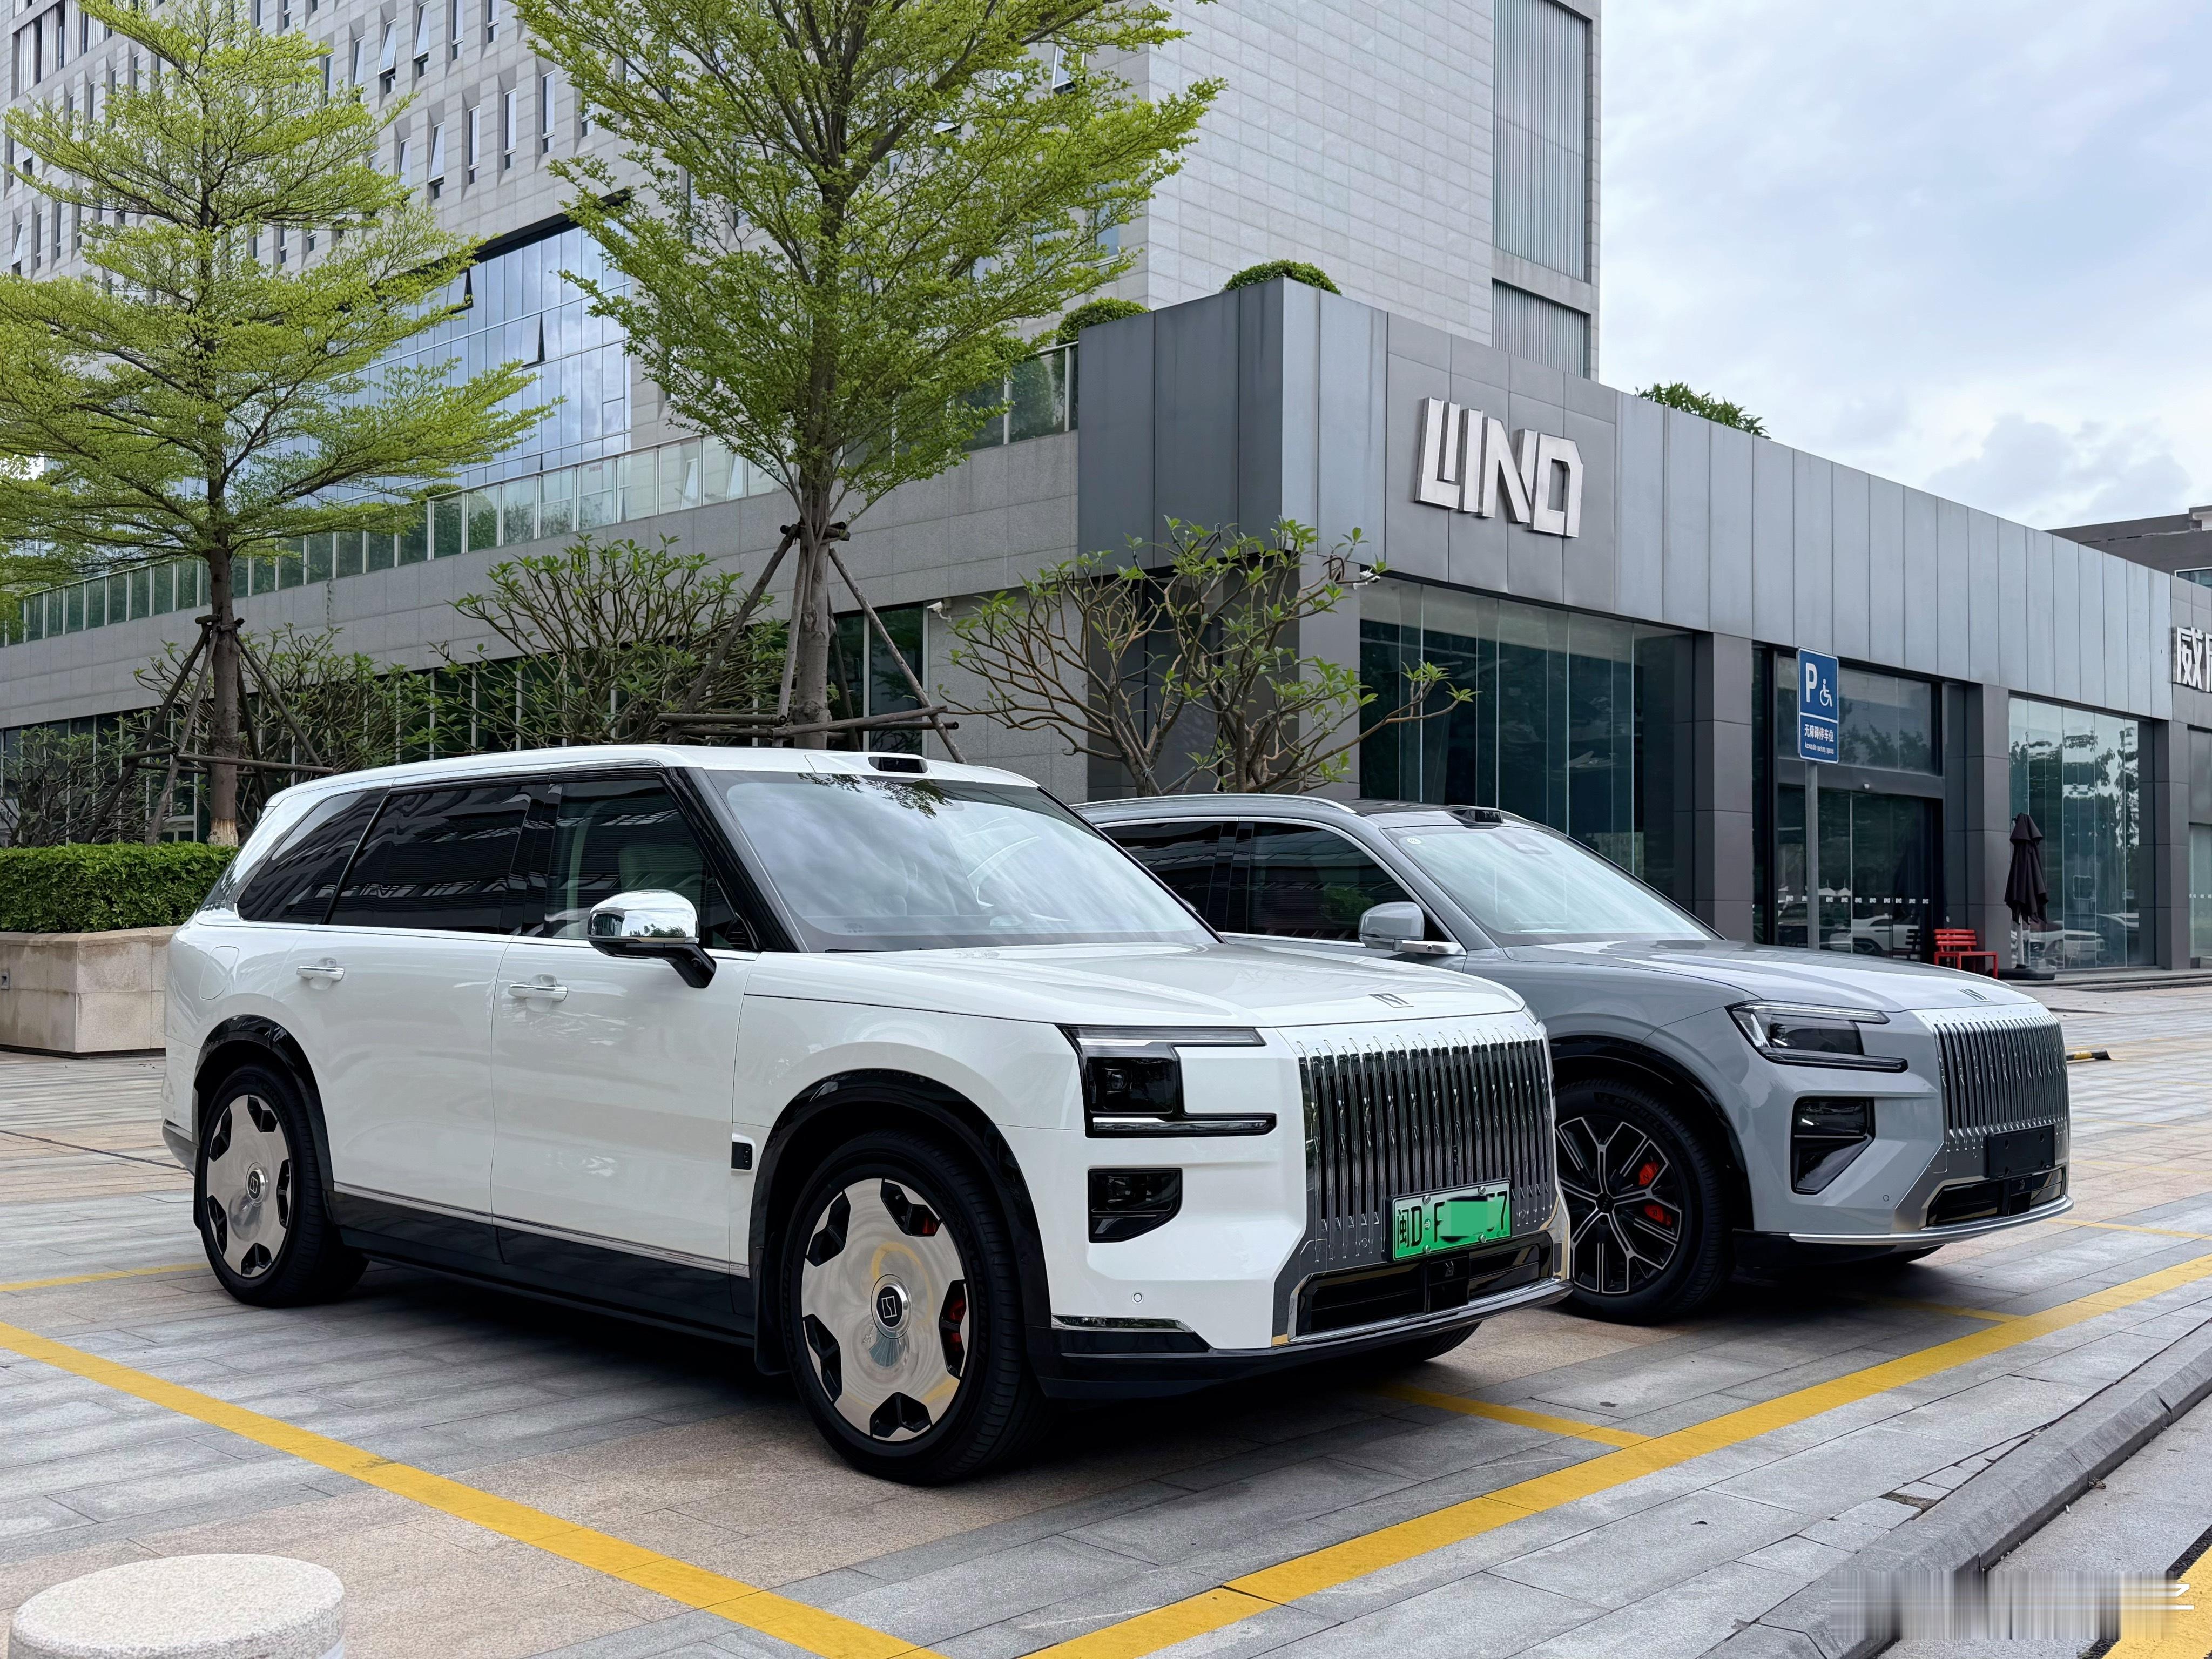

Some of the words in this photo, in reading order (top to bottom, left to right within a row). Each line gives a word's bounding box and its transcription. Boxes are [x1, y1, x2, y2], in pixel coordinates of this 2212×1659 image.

[1805, 662, 1817, 703] P
[1804, 724, 1835, 743] 无障碍停车位
[1613, 1097, 1675, 1141] MICHELIN
